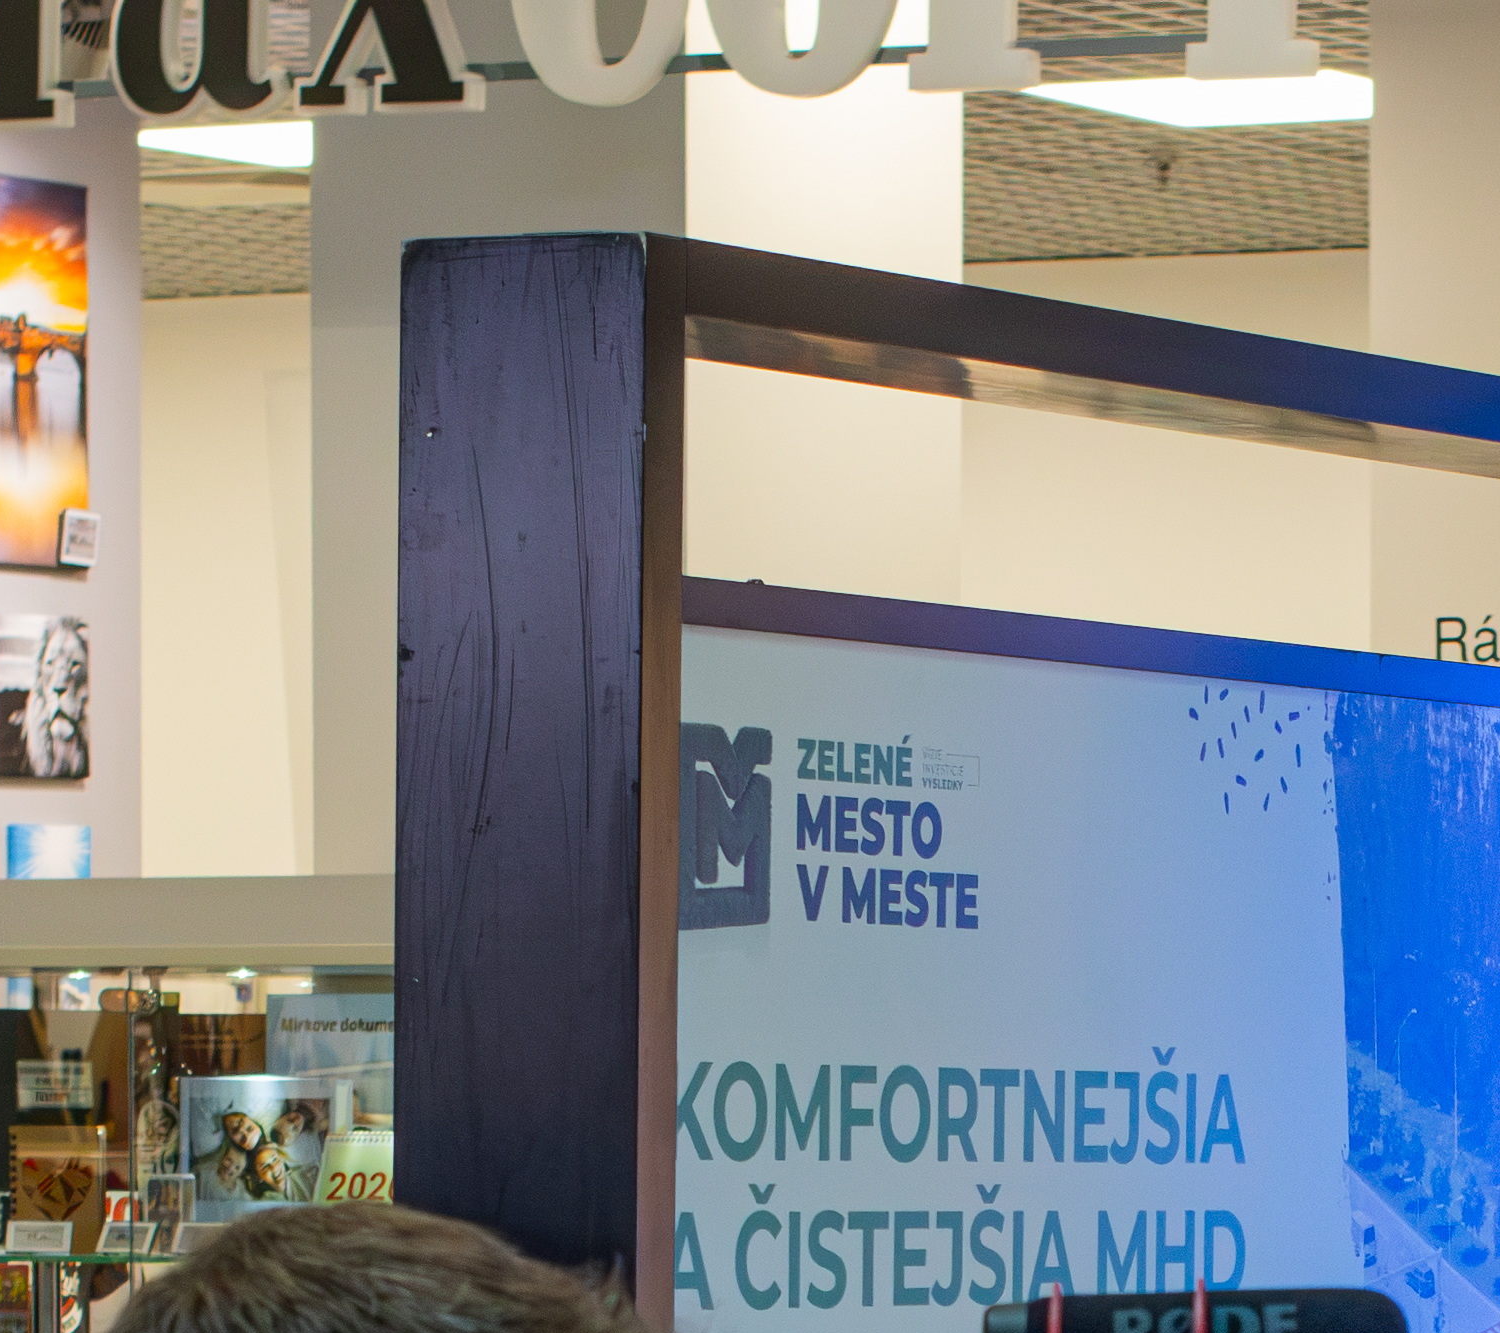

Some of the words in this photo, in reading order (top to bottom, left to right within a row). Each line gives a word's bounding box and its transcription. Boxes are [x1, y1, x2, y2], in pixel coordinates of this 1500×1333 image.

[797, 734, 913, 787] ZELENÉ
[796, 793, 943, 860] MESTO
[796, 864, 829, 922] V
[841, 866, 979, 930] MESTE
[676, 1046, 1246, 1166] KOMFORTNEJŠIA
[326, 1172, 394, 1200] 202
[674, 1211, 714, 1311] A
[735, 1183, 1075, 1311] ČISTEJŠIA
[1097, 1209, 1246, 1292] MHD
